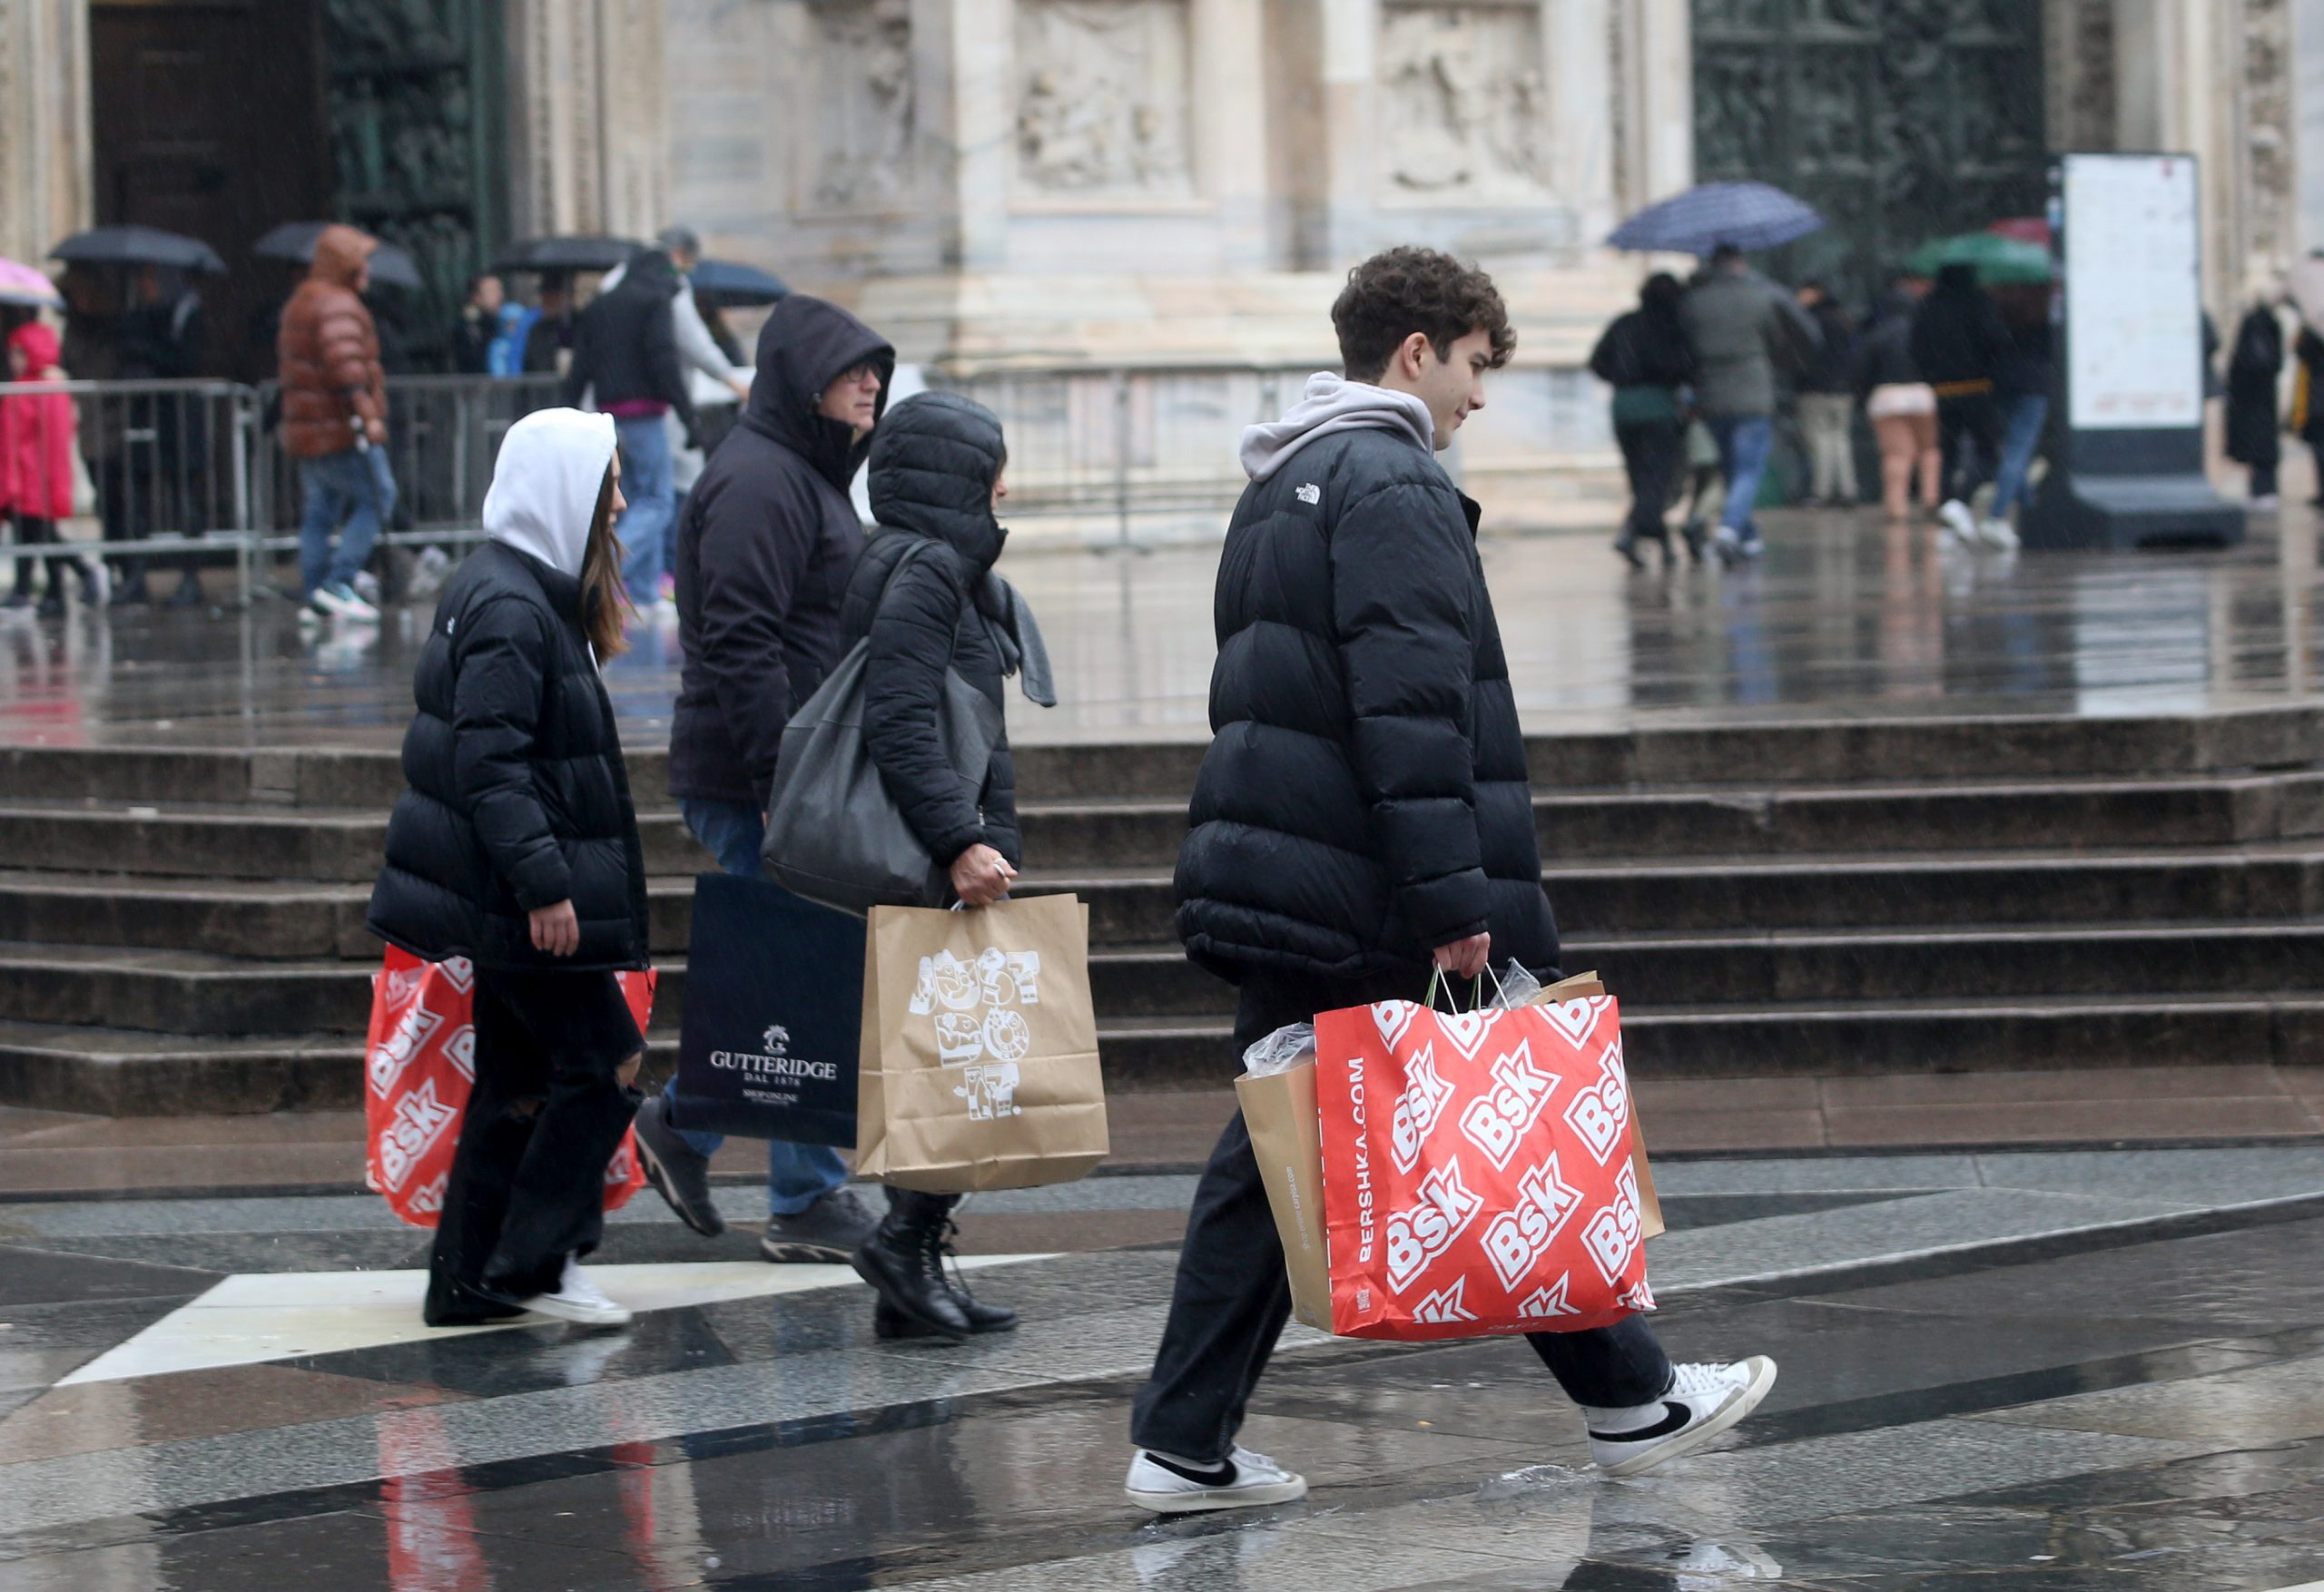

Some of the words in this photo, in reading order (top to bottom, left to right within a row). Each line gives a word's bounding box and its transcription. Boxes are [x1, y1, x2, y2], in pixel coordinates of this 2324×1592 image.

[909, 947, 1040, 1015] JUST
[710, 1050, 837, 1080] GUTTERIDGE
[743, 1072, 769, 1085] DAL
[935, 1006, 1030, 1068] DO
[380, 1096, 445, 1182] BSK
[1391, 1058, 1444, 1163] BSK
[1464, 1057, 1551, 1160] BSK
[1348, 1057, 1374, 1263] BERSHKA.COM
[1386, 1174, 1474, 1282] BSK
[1488, 1172, 1573, 1282] BSK
